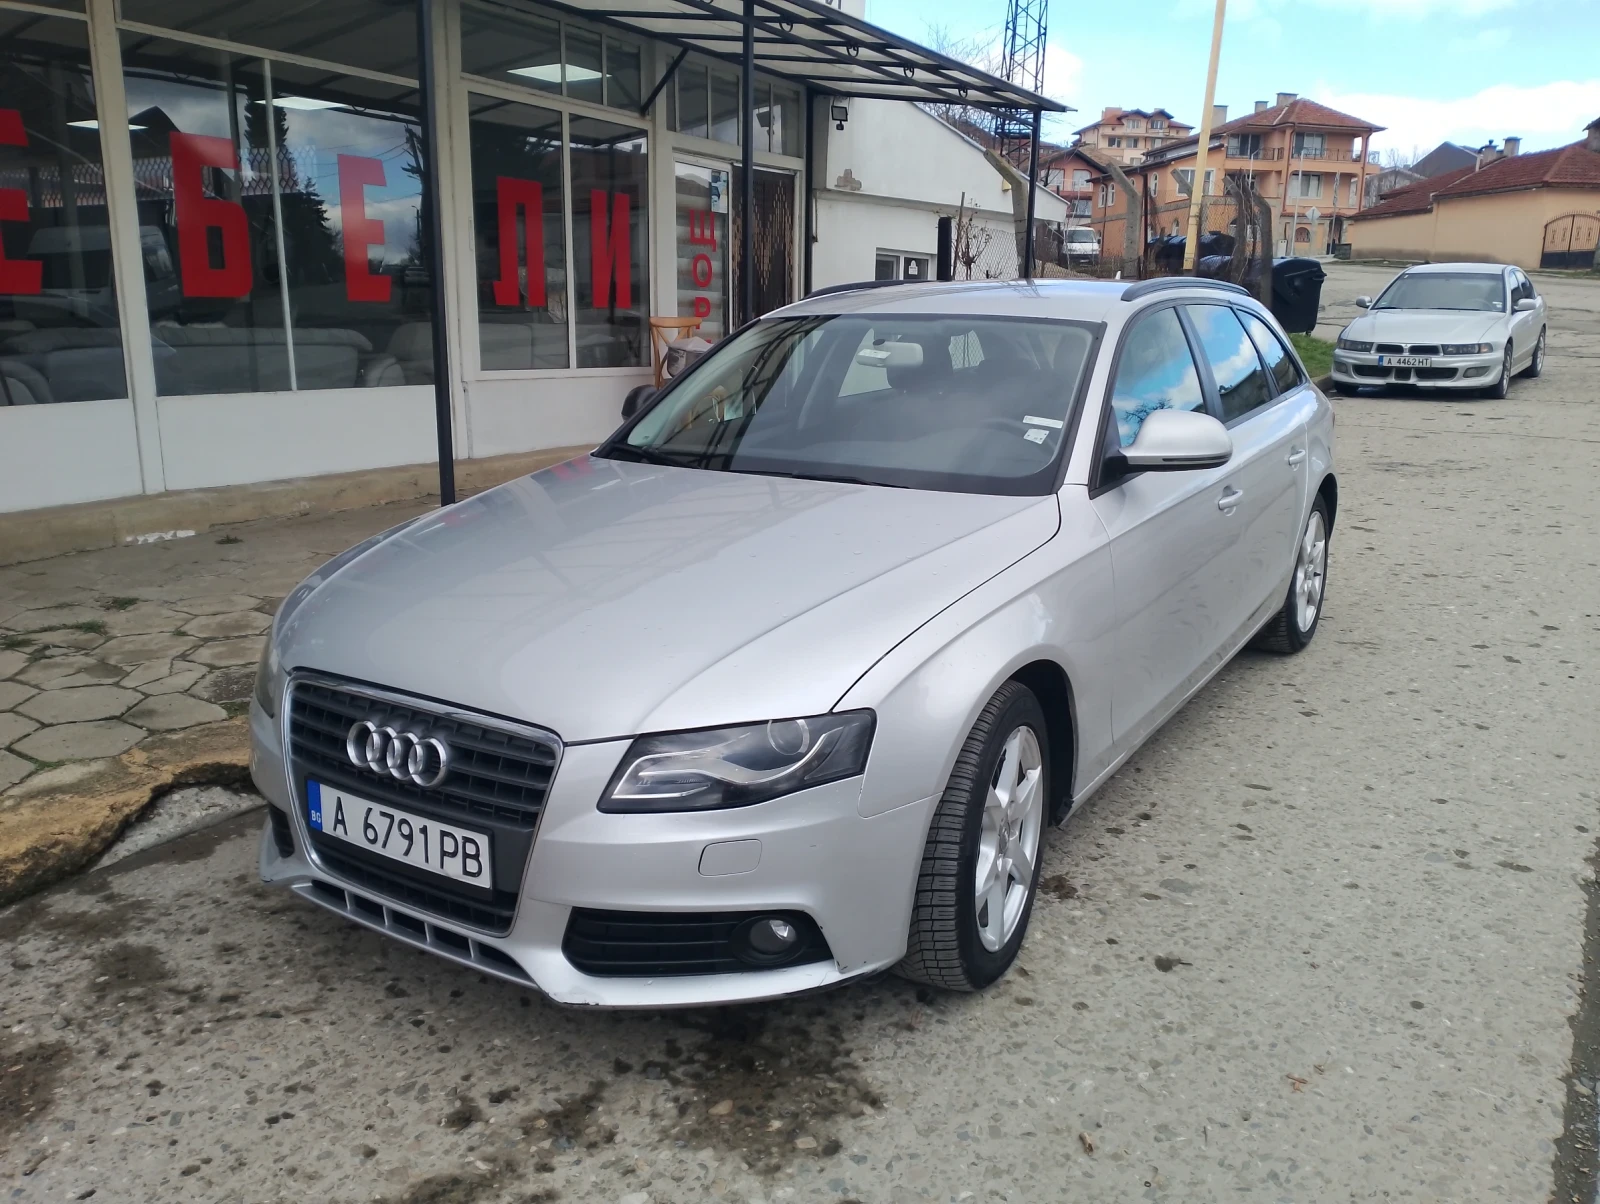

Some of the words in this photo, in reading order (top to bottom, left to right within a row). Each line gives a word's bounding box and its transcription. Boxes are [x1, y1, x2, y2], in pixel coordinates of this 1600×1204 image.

[690, 209, 716, 344] ЩОР
[311, 810, 322, 823] BG
[333, 796, 348, 836] A
